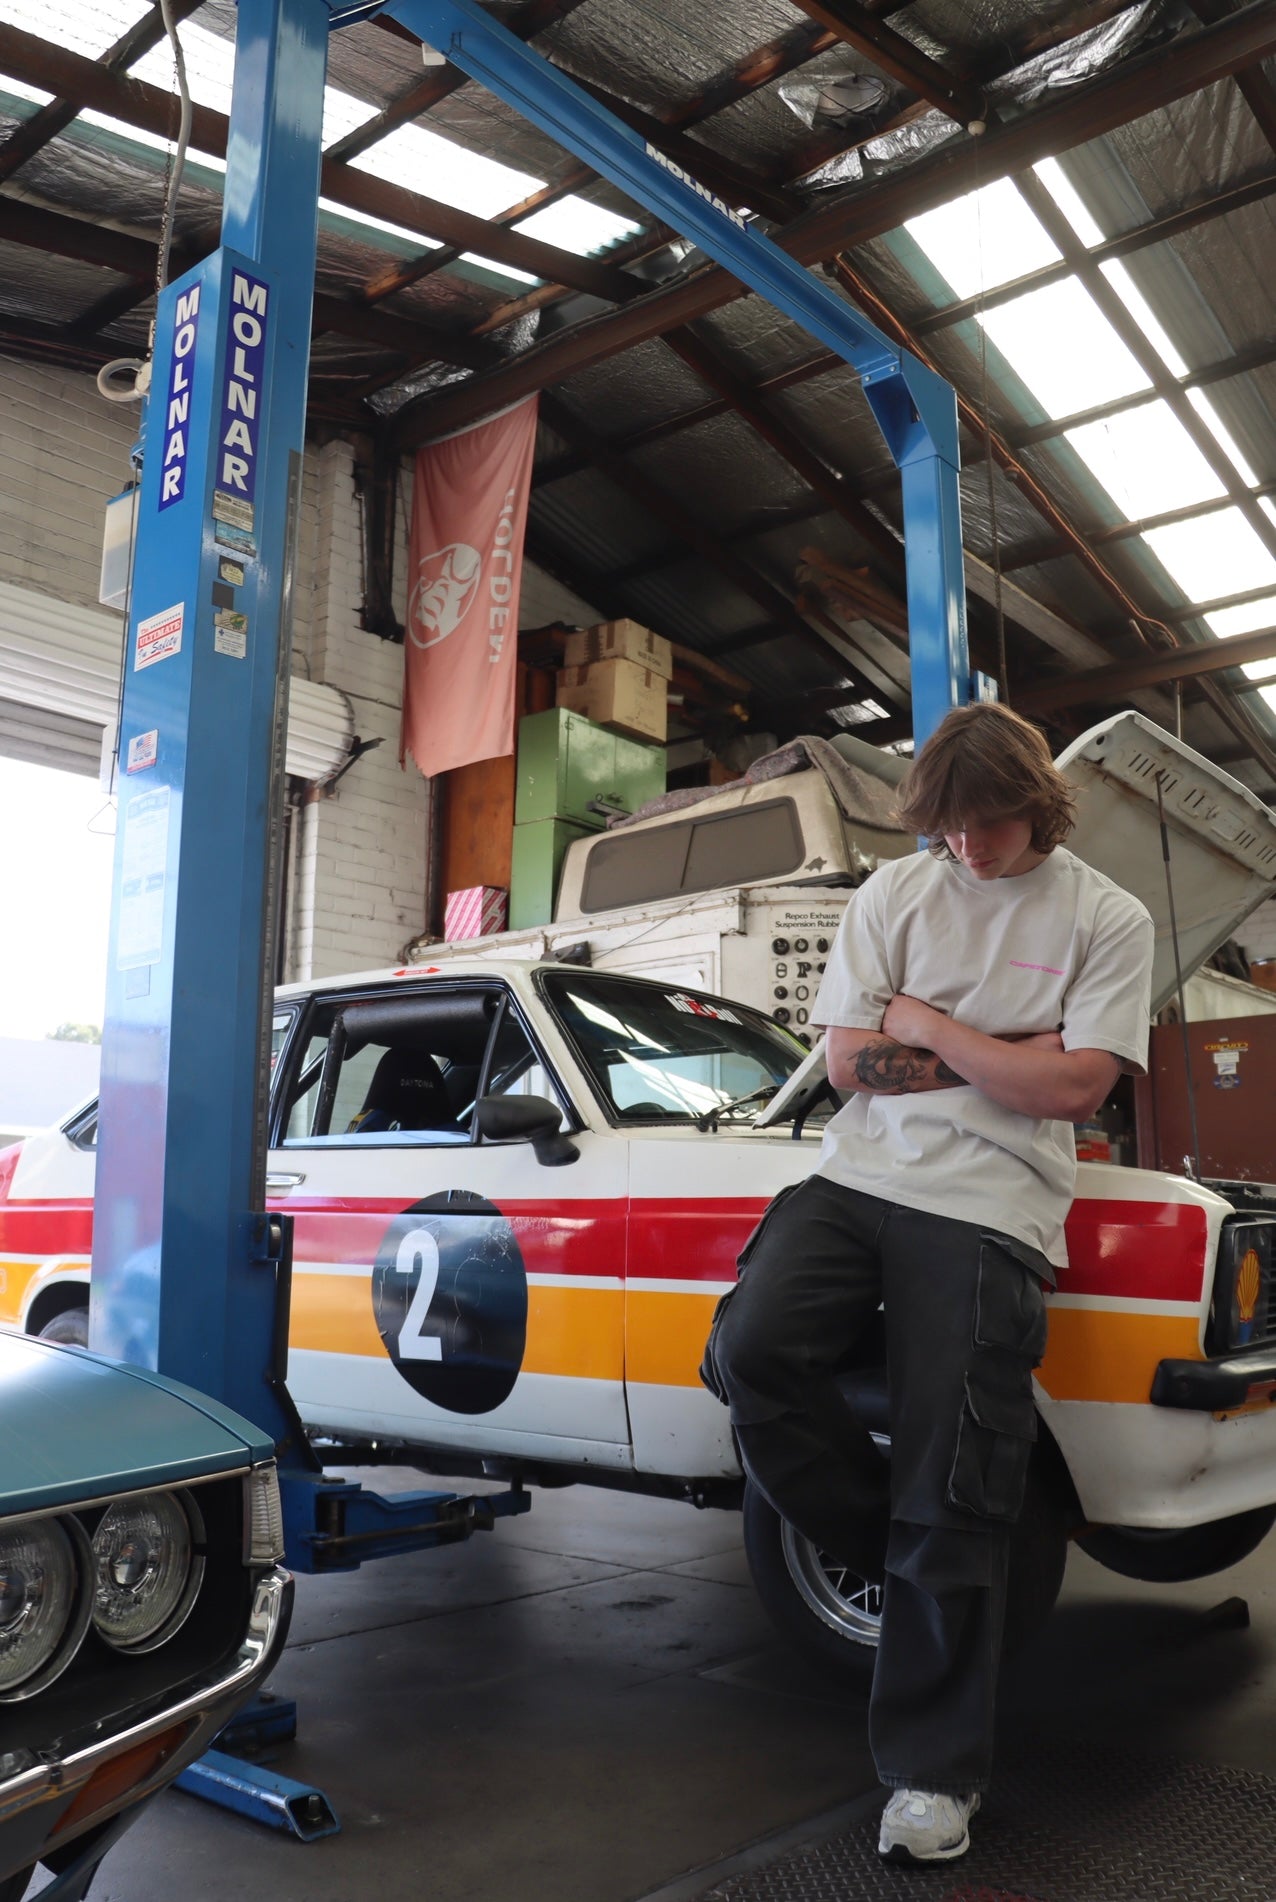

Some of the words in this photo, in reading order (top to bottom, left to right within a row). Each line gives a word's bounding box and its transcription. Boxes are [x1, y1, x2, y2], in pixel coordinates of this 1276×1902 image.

[646, 142, 746, 231] MOLNAR
[163, 286, 200, 502] MOLNAR
[223, 274, 267, 491] MOLNAR
[139, 619, 182, 647] ULTIMATE
[151, 636, 178, 654] Safety
[775, 920, 816, 929] Suspension
[785, 912, 808, 921] Repco
[810, 912, 840, 920] Exhaust
[396, 1230, 442, 1361] 2
